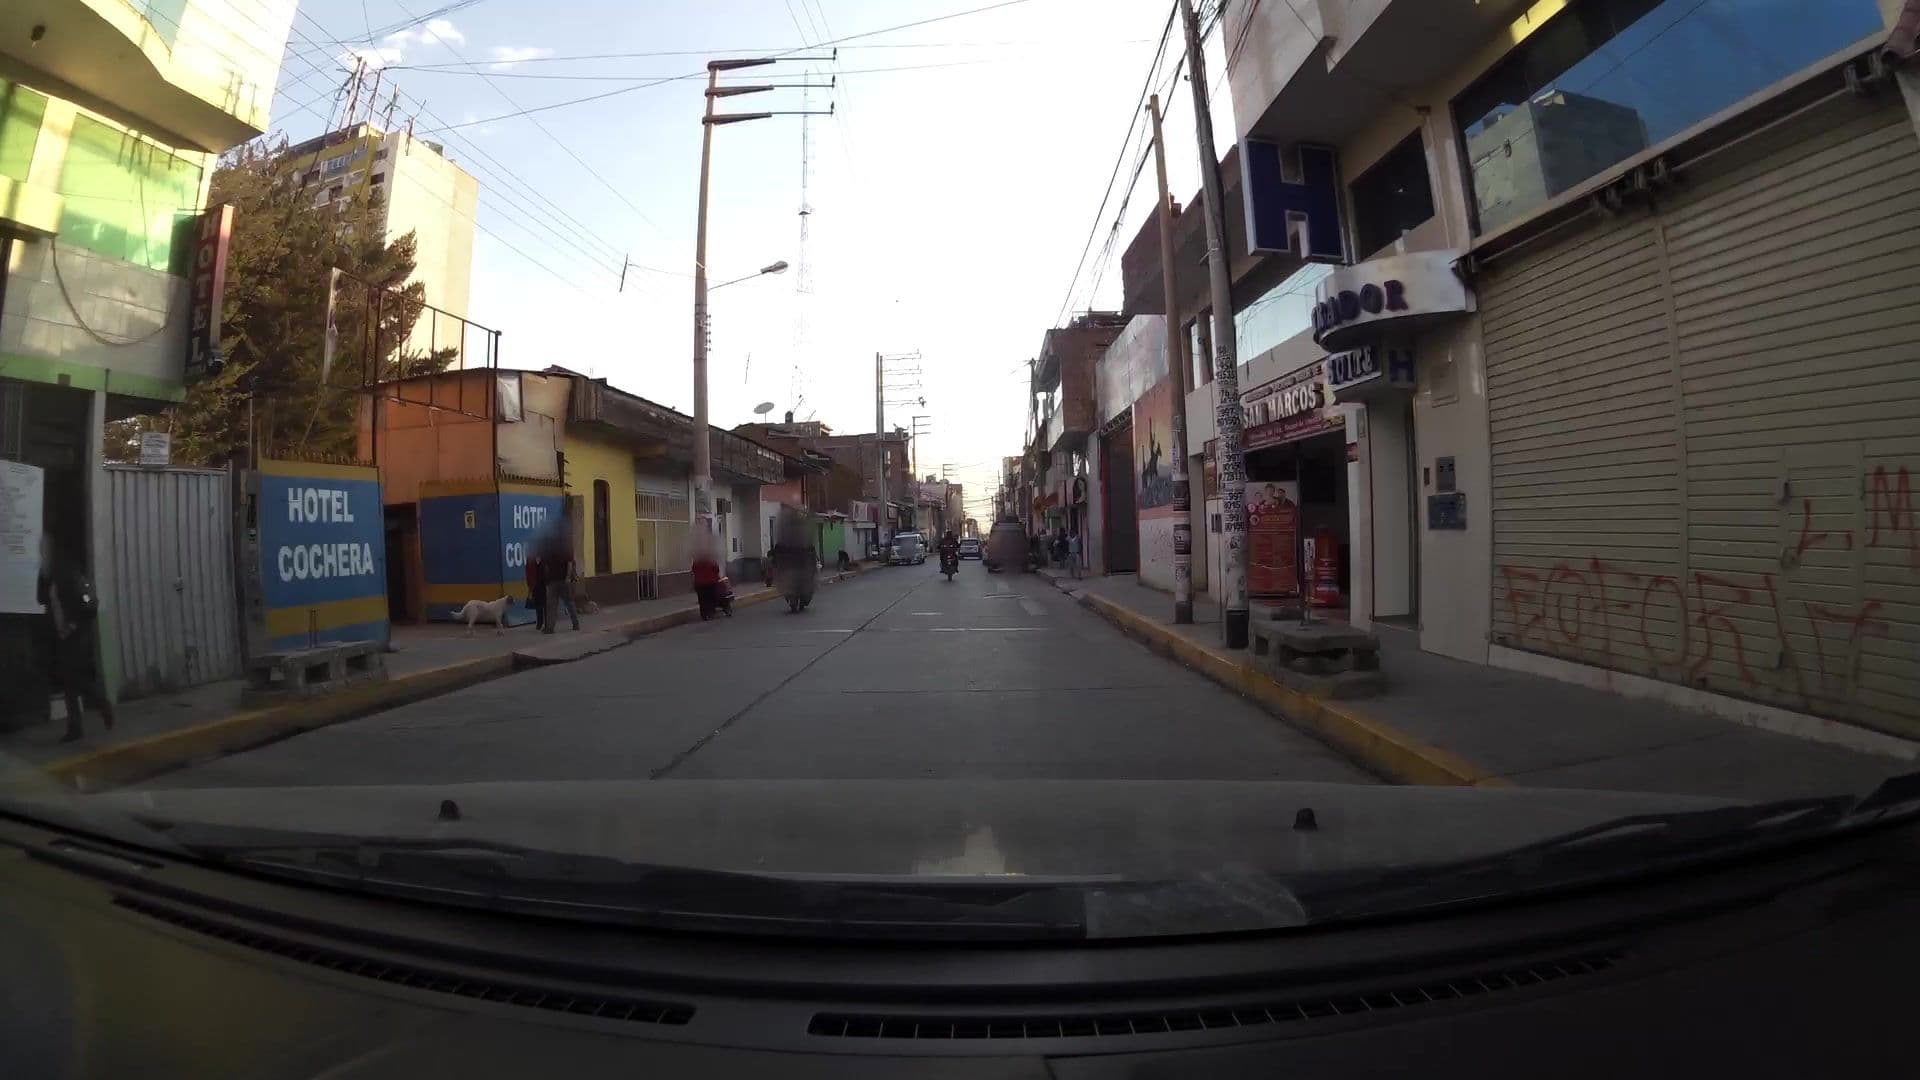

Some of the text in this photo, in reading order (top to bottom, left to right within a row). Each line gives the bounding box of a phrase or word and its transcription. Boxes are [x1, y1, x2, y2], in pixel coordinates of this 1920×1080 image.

[191, 212, 217, 364] HOTEL
[1267, 384, 1317, 422] MARCOS
[288, 487, 355, 524] HOTEL
[278, 542, 375, 583] COCHERA
